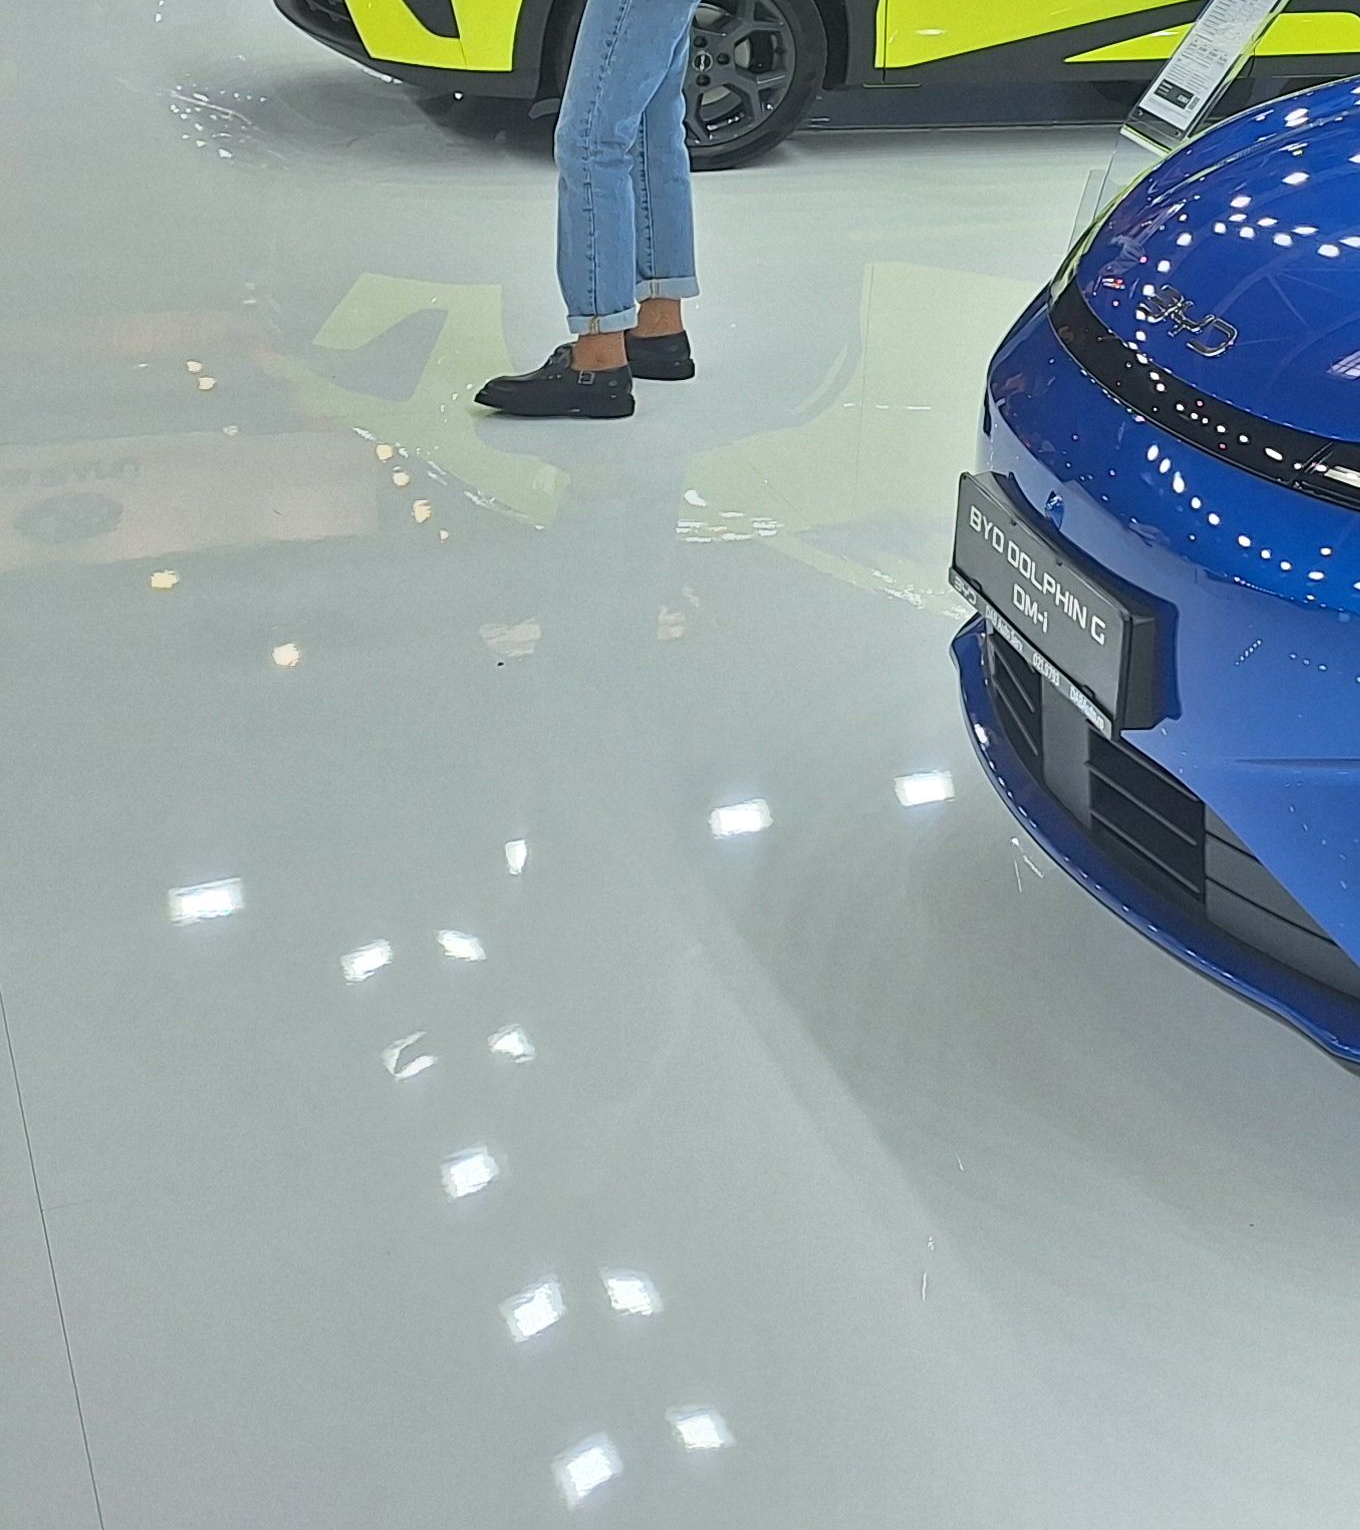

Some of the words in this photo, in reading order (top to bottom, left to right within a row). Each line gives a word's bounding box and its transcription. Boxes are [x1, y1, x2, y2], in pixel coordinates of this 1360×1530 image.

[969, 504, 1005, 555] BYD
[1006, 539, 1087, 630] DOLPHIN
[1013, 582, 1049, 634] DM-i
